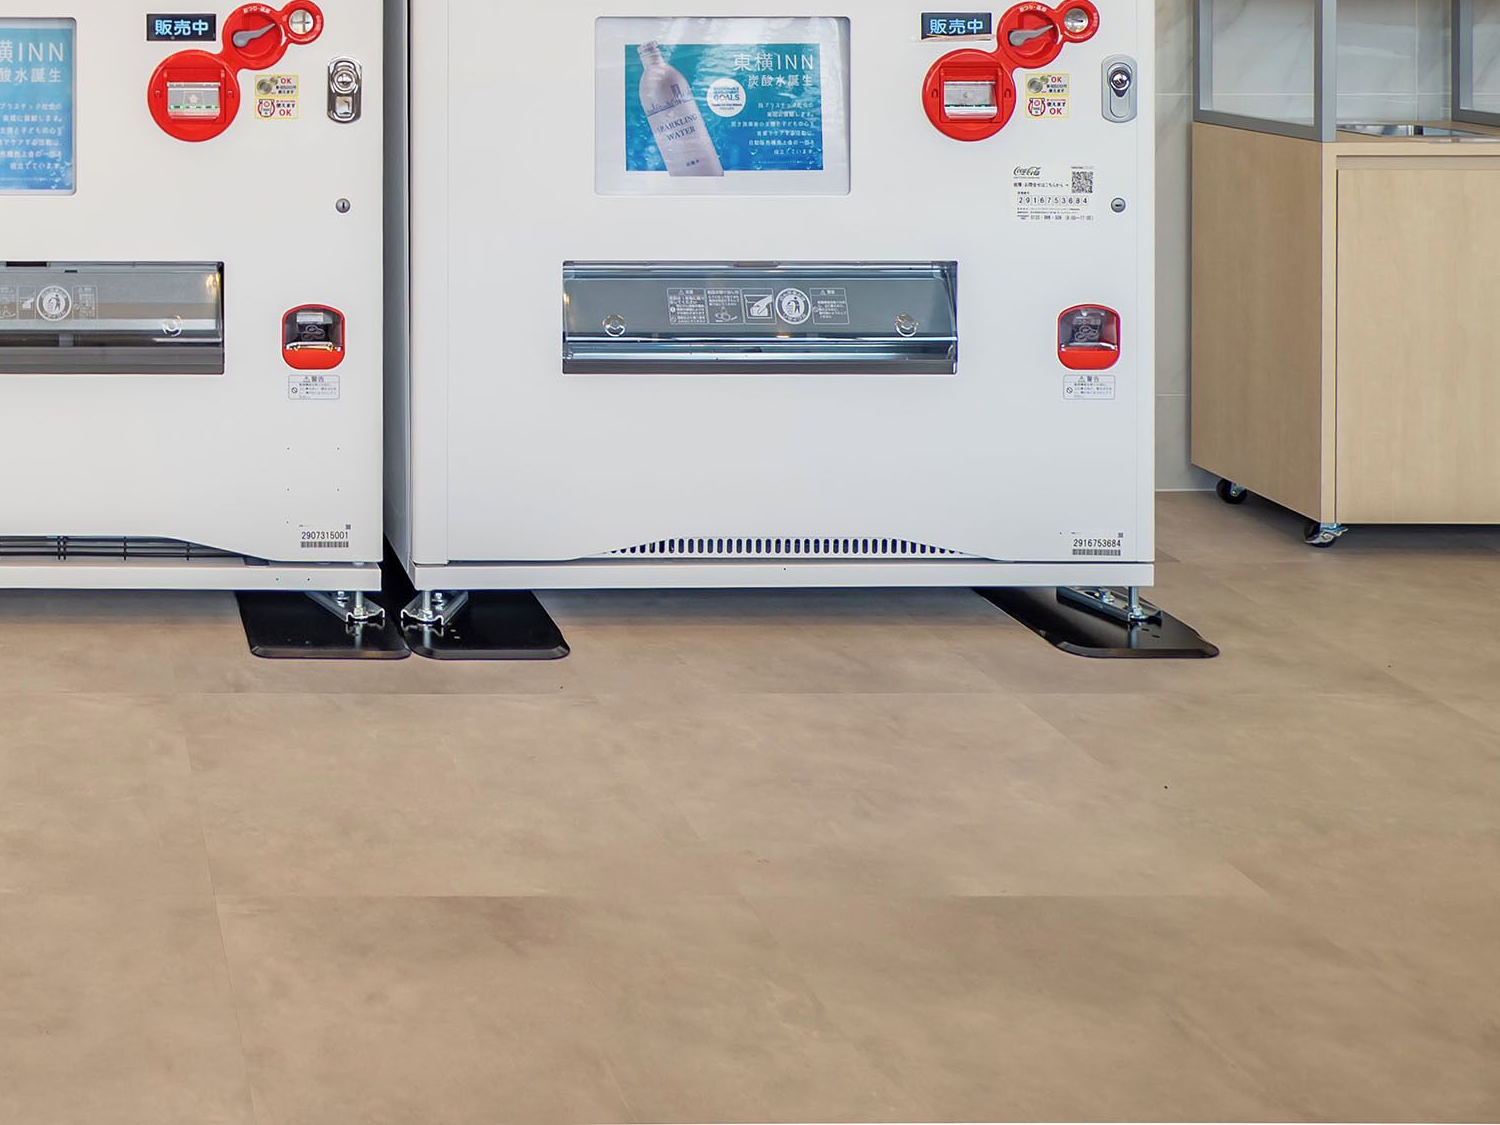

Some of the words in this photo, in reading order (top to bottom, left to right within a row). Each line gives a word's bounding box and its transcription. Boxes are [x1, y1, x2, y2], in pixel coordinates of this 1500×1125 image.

[155, 19, 209, 36] 販売中
[929, 18, 984, 35] 販売中
[734, 53, 814, 72] 東横INN
[280, 77, 292, 85] OK
[748, 74, 813, 87] 炭酸水誕生
[713, 93, 741, 101] GOALS
[278, 108, 292, 116] OK
[1049, 107, 1063, 115] OK
[301, 530, 349, 540] 2907315001
[1072, 539, 1122, 548] 2916753684
